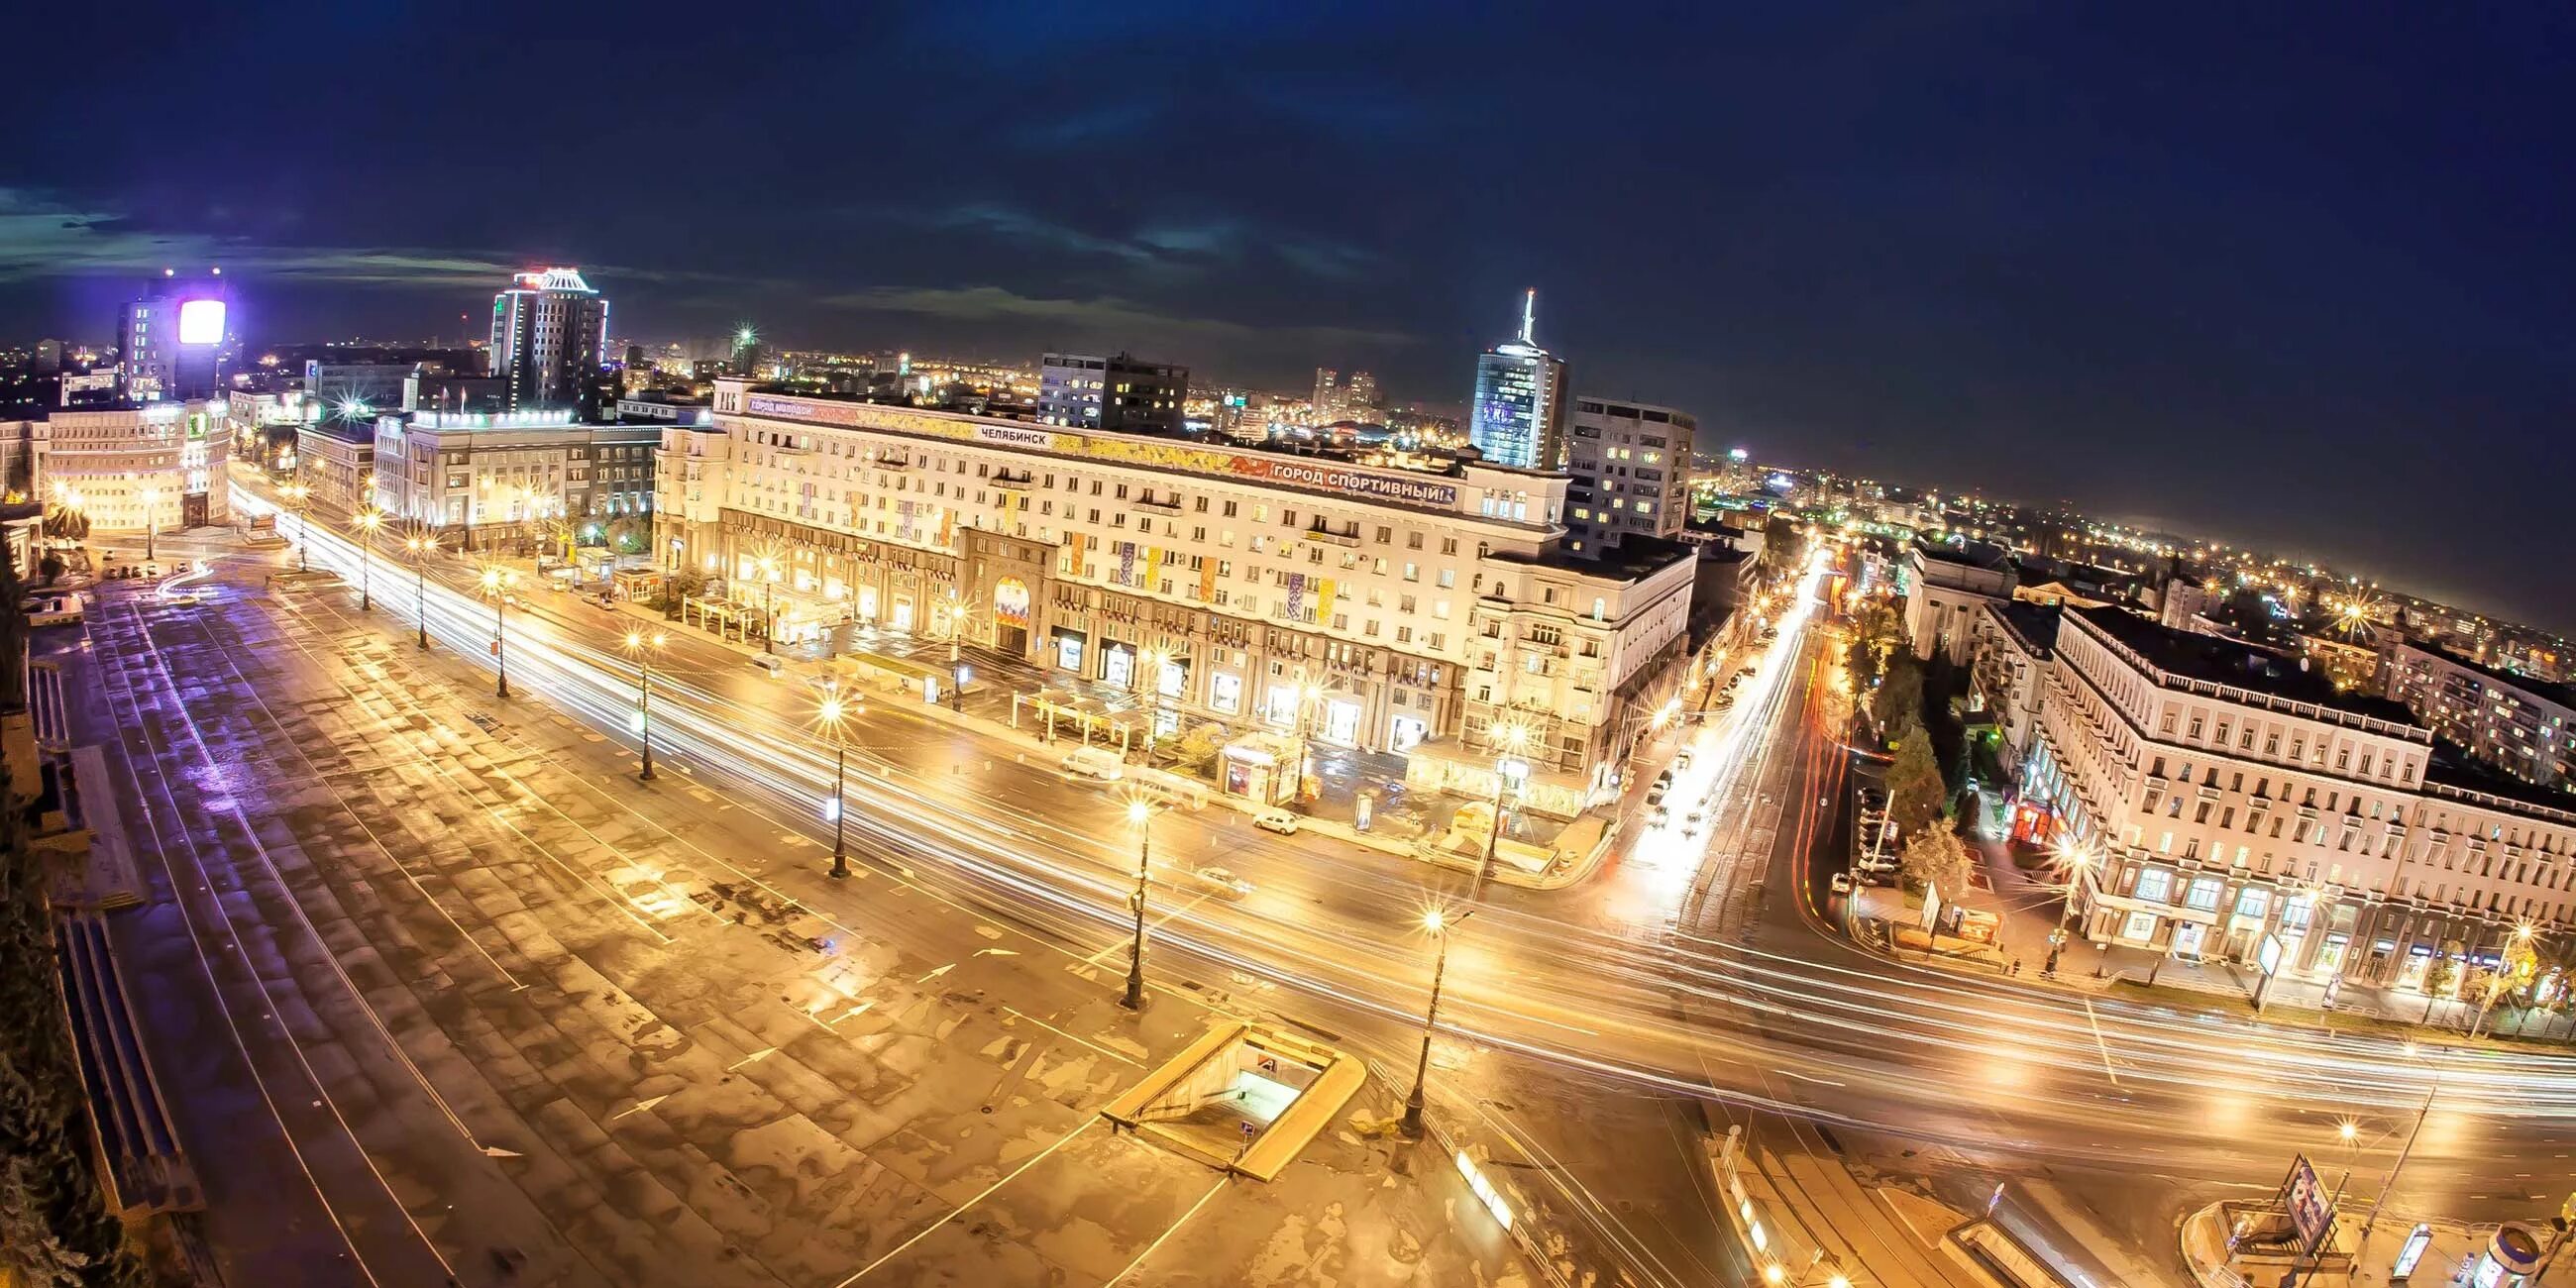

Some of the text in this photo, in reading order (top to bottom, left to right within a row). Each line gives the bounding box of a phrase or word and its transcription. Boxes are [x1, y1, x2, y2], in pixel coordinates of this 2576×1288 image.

[981, 427, 1046, 445] ЧЕЛЯБИНСК
[1273, 465, 1445, 501] ГОРОД СПОРТИВНЫЙ!
